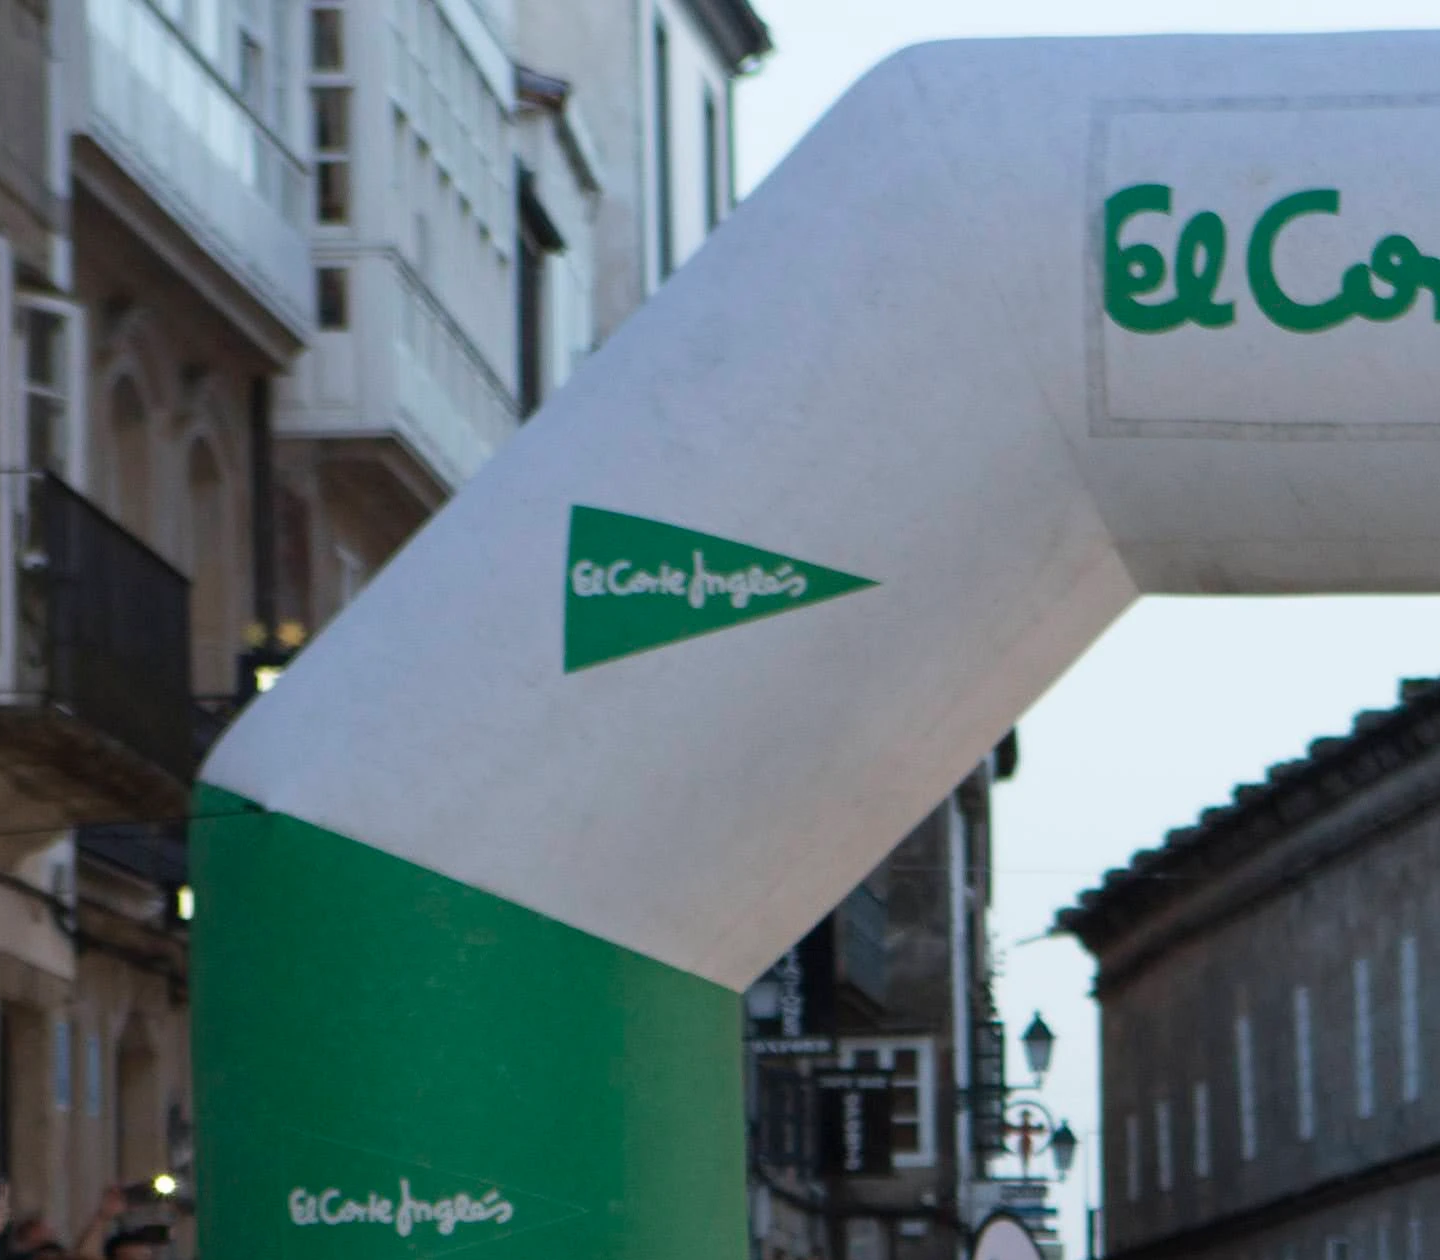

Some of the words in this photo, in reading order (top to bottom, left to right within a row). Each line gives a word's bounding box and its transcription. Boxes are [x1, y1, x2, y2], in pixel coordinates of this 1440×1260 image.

[1103, 183, 1236, 335] El
[570, 559, 607, 597] El
[607, 559, 687, 597] Corte
[687, 548, 808, 610] Inglés
[288, 1187, 319, 1226] El
[319, 1187, 393, 1226] Corte
[396, 1176, 514, 1238] Inglés
